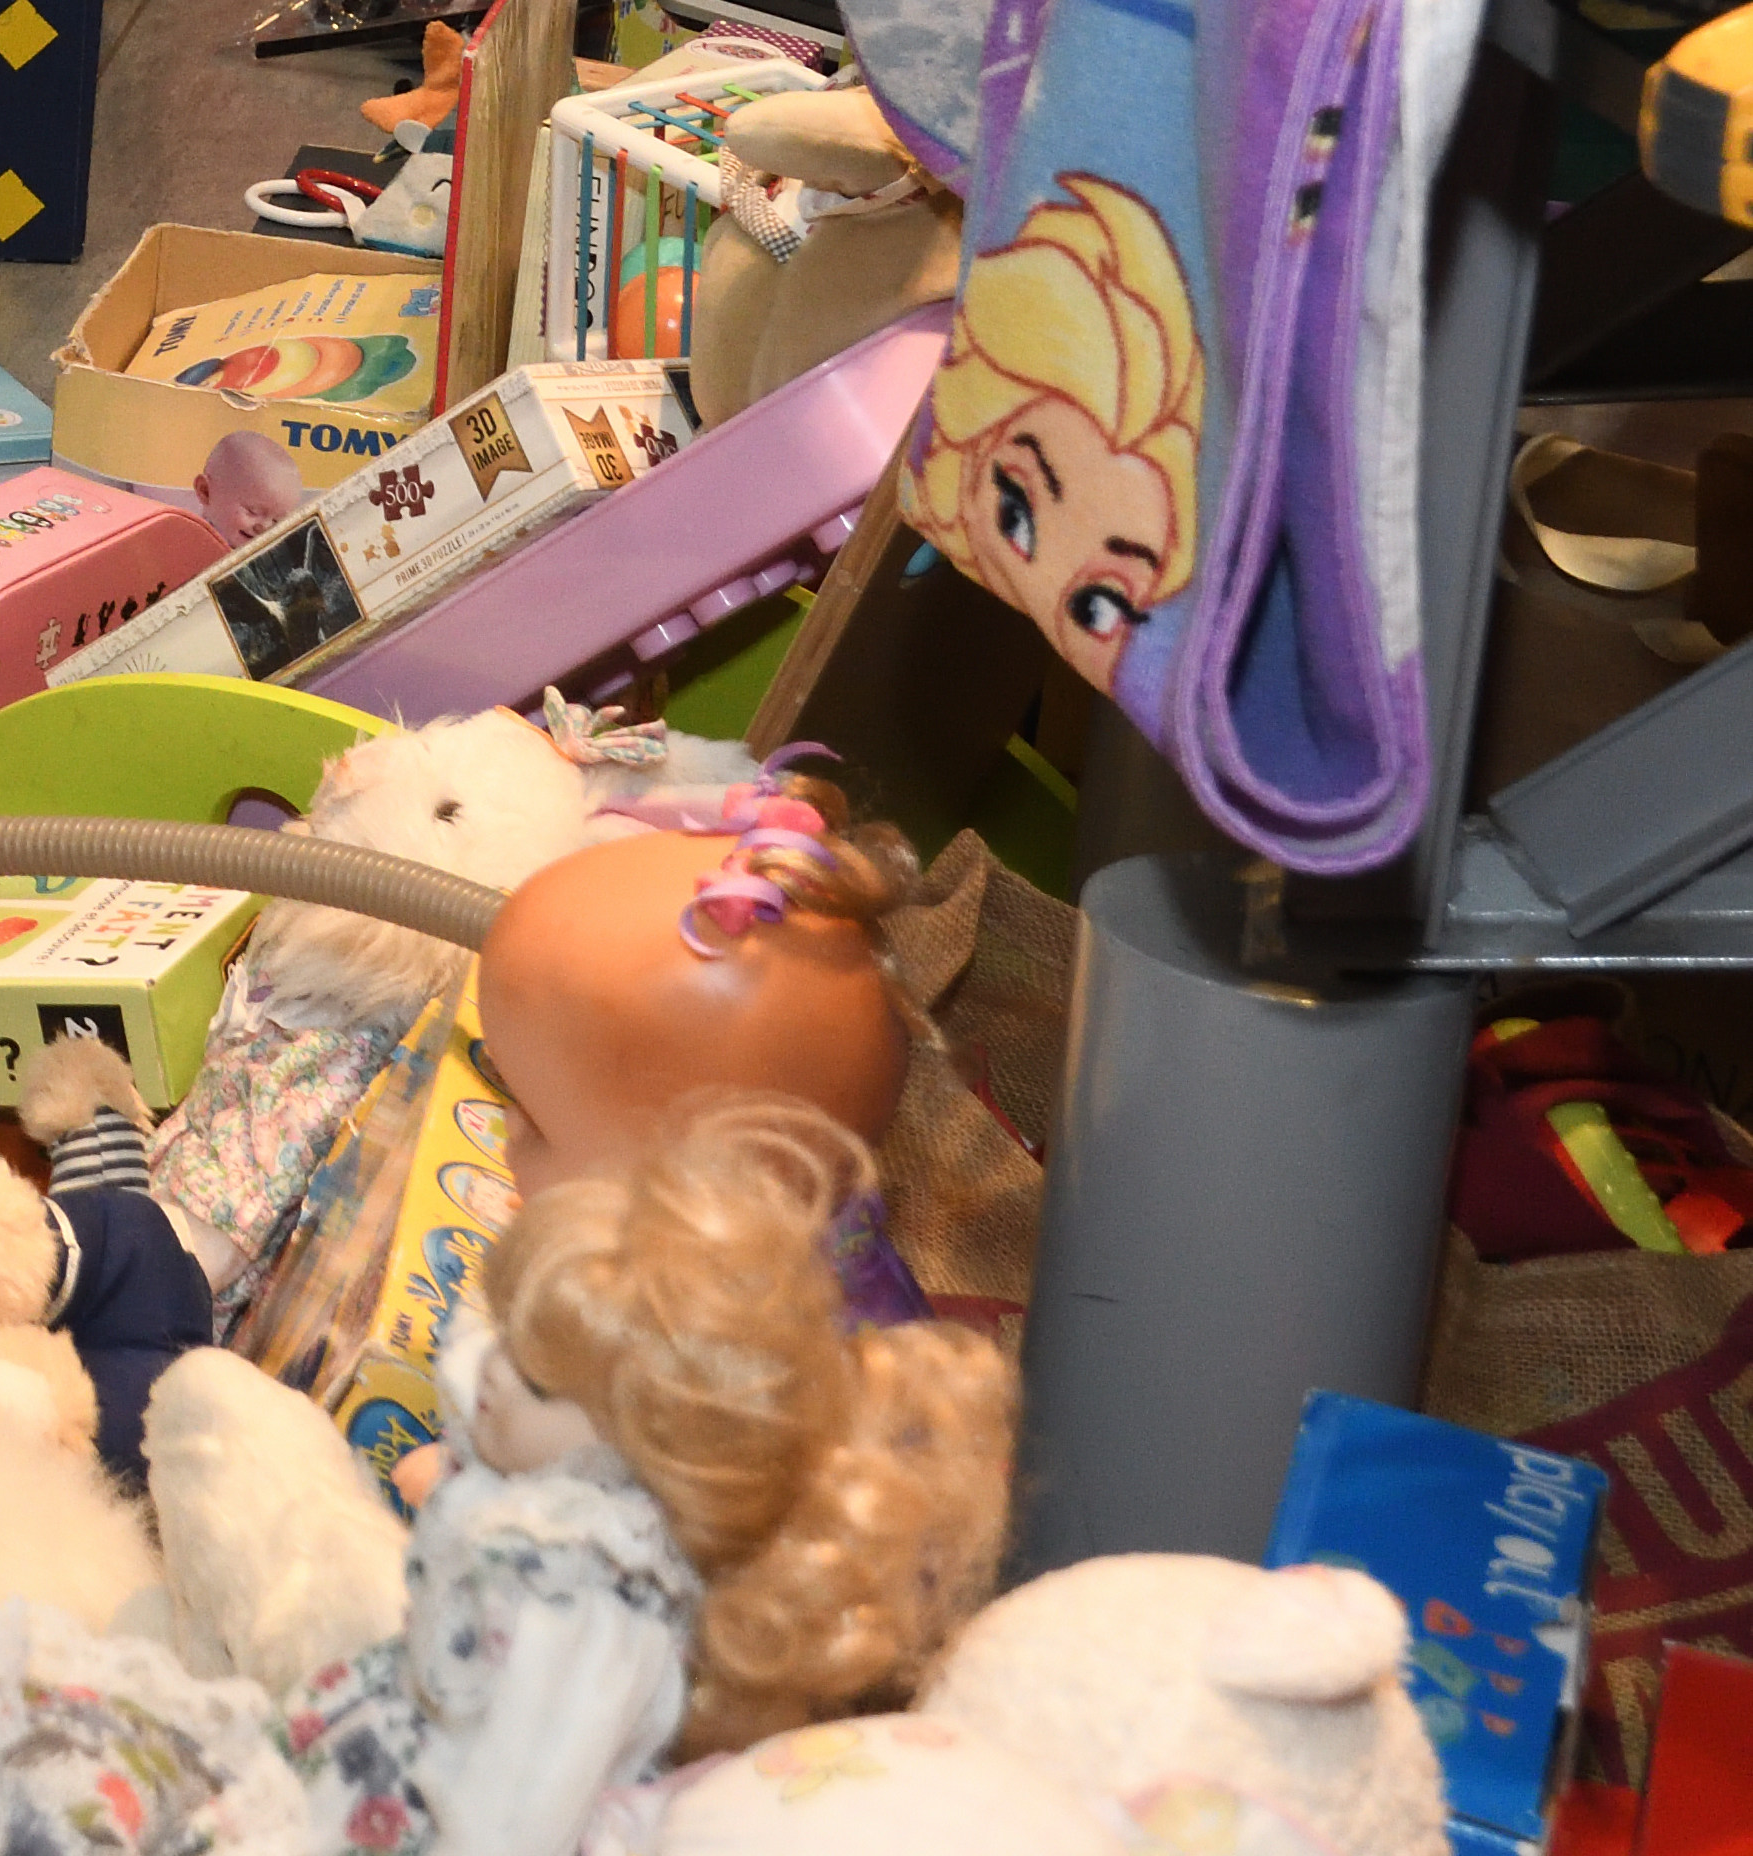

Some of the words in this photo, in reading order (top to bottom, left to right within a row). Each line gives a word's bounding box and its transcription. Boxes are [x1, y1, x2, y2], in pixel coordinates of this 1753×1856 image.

[153, 315, 197, 357] TOMY
[465, 407, 498, 444] 3D
[581, 430, 614, 451] IMAGE
[471, 432, 515, 472] IMAGE
[596, 452, 624, 481] 3D
[384, 481, 421, 506] 500
[395, 560, 423, 587] PRIME
[432, 538, 464, 565] PUZZLE
[84, 900, 163, 949] FAIT
[134, 893, 223, 950] MENT
